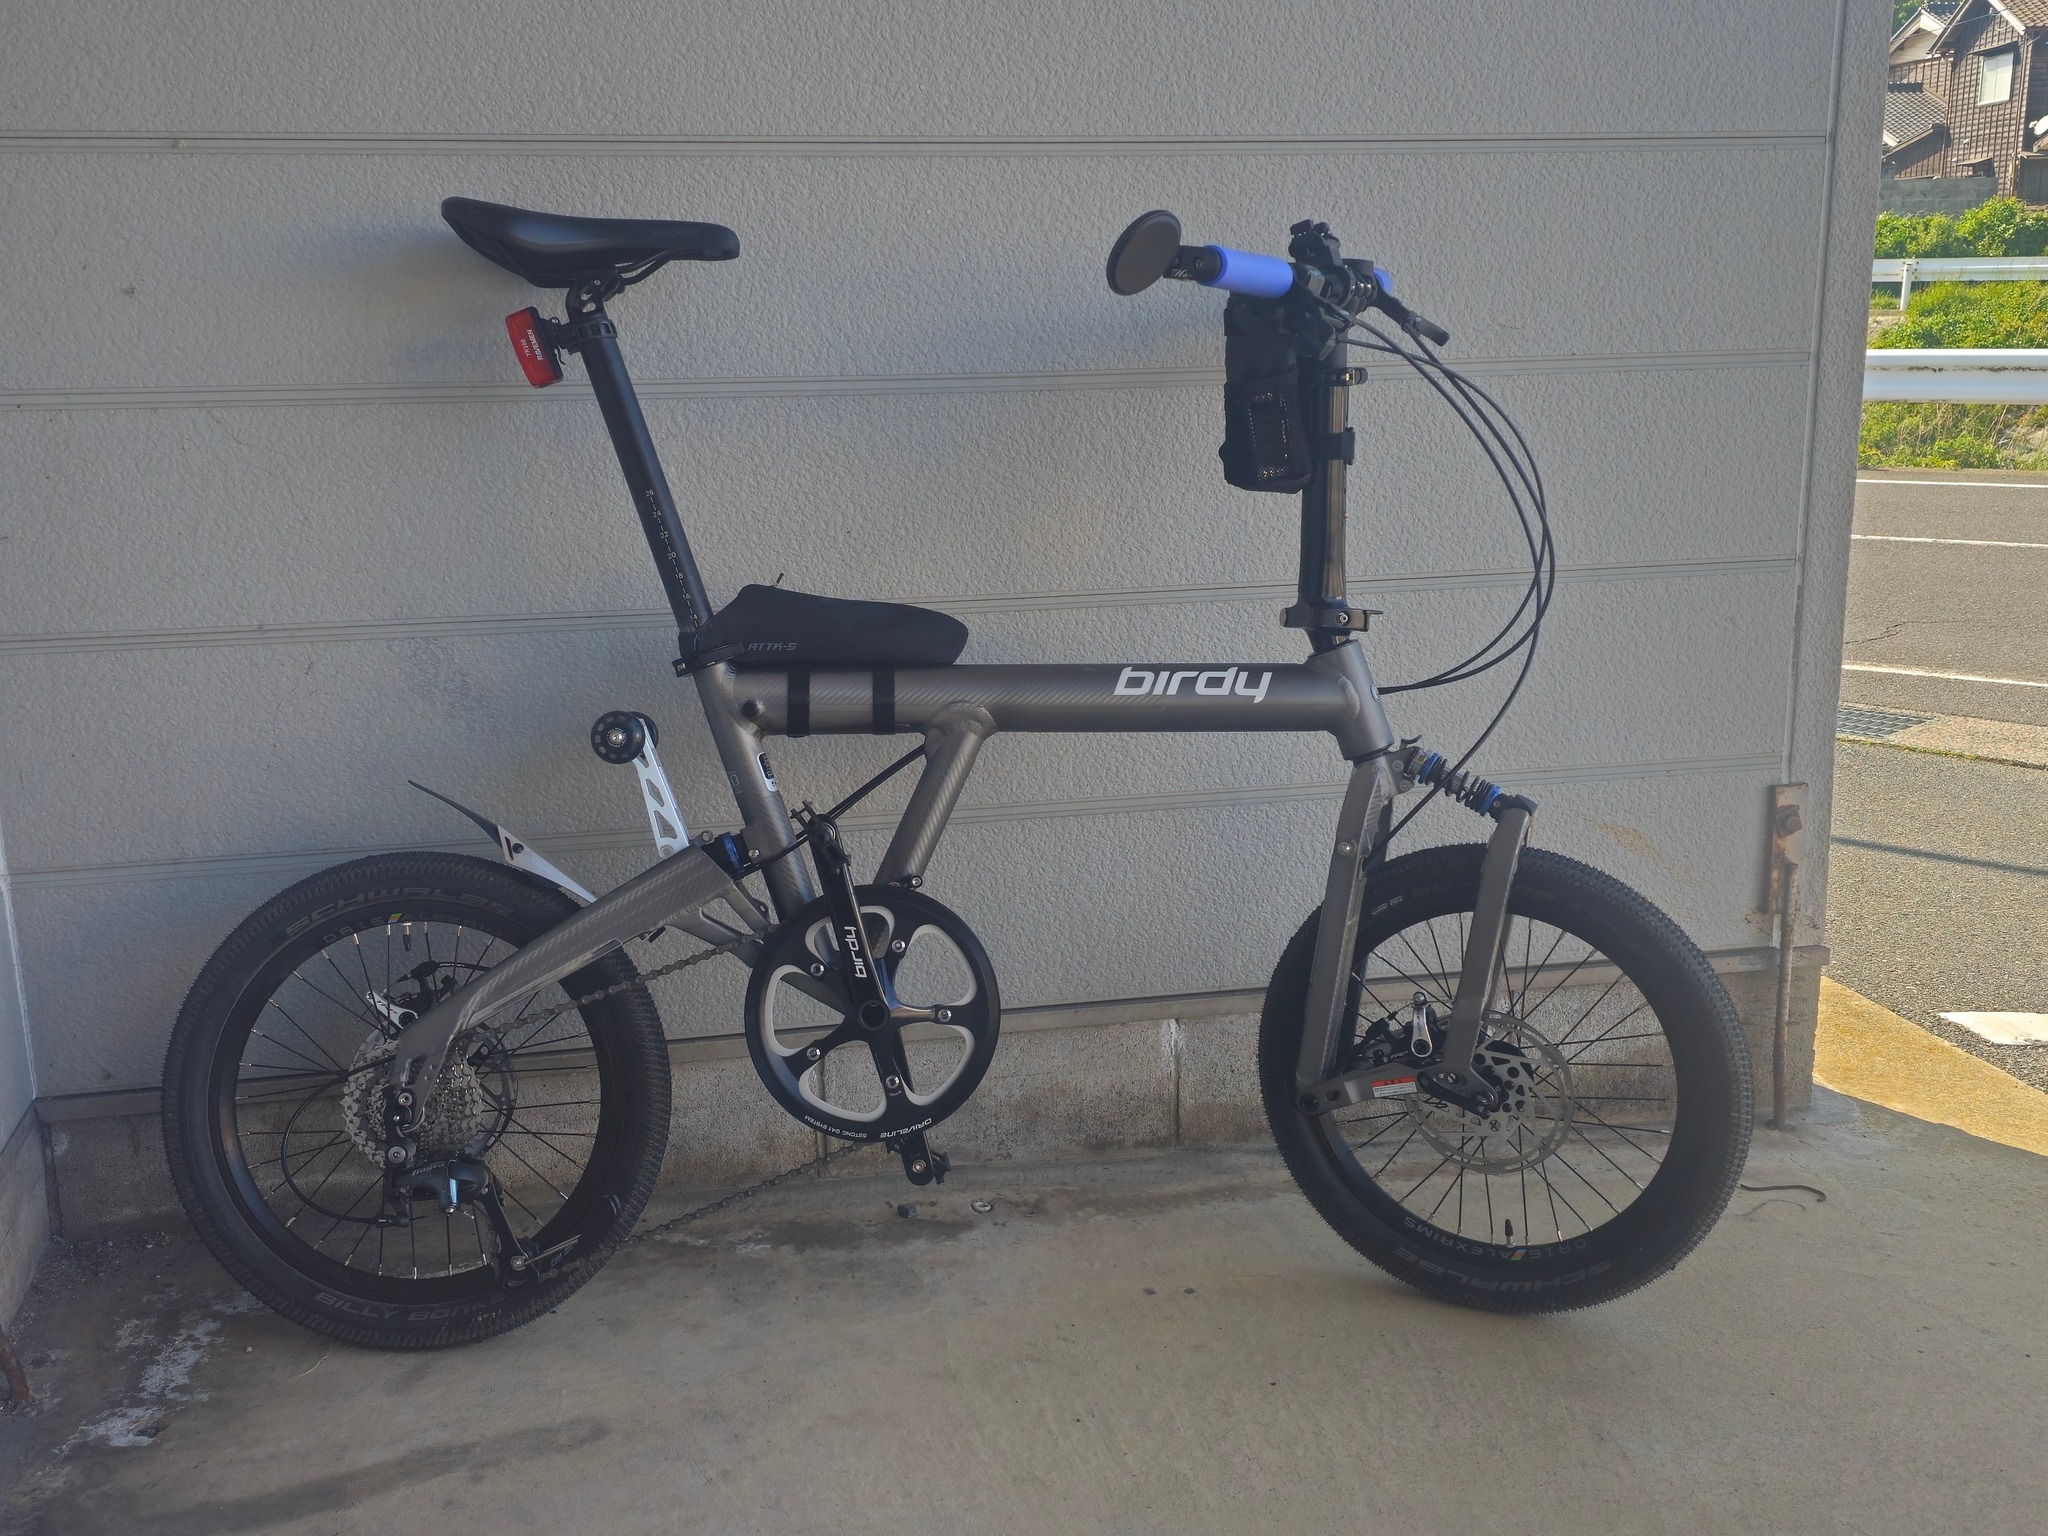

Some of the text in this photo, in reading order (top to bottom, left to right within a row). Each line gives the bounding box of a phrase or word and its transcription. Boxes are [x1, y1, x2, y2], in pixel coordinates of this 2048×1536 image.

[526, 328, 545, 361] RAVEMEN
[659, 530, 670, 539] 22
[667, 551, 677, 560] 20
[675, 571, 684, 580] 18
[1113, 666, 1273, 704] birdy
[285, 886, 515, 938] SCHWALBE
[843, 925, 868, 979] birdy
[1402, 1215, 1512, 1258] ALEXRIMS
[1392, 1245, 1612, 1292] SCHWALBE
[314, 1291, 400, 1320] BILLY
